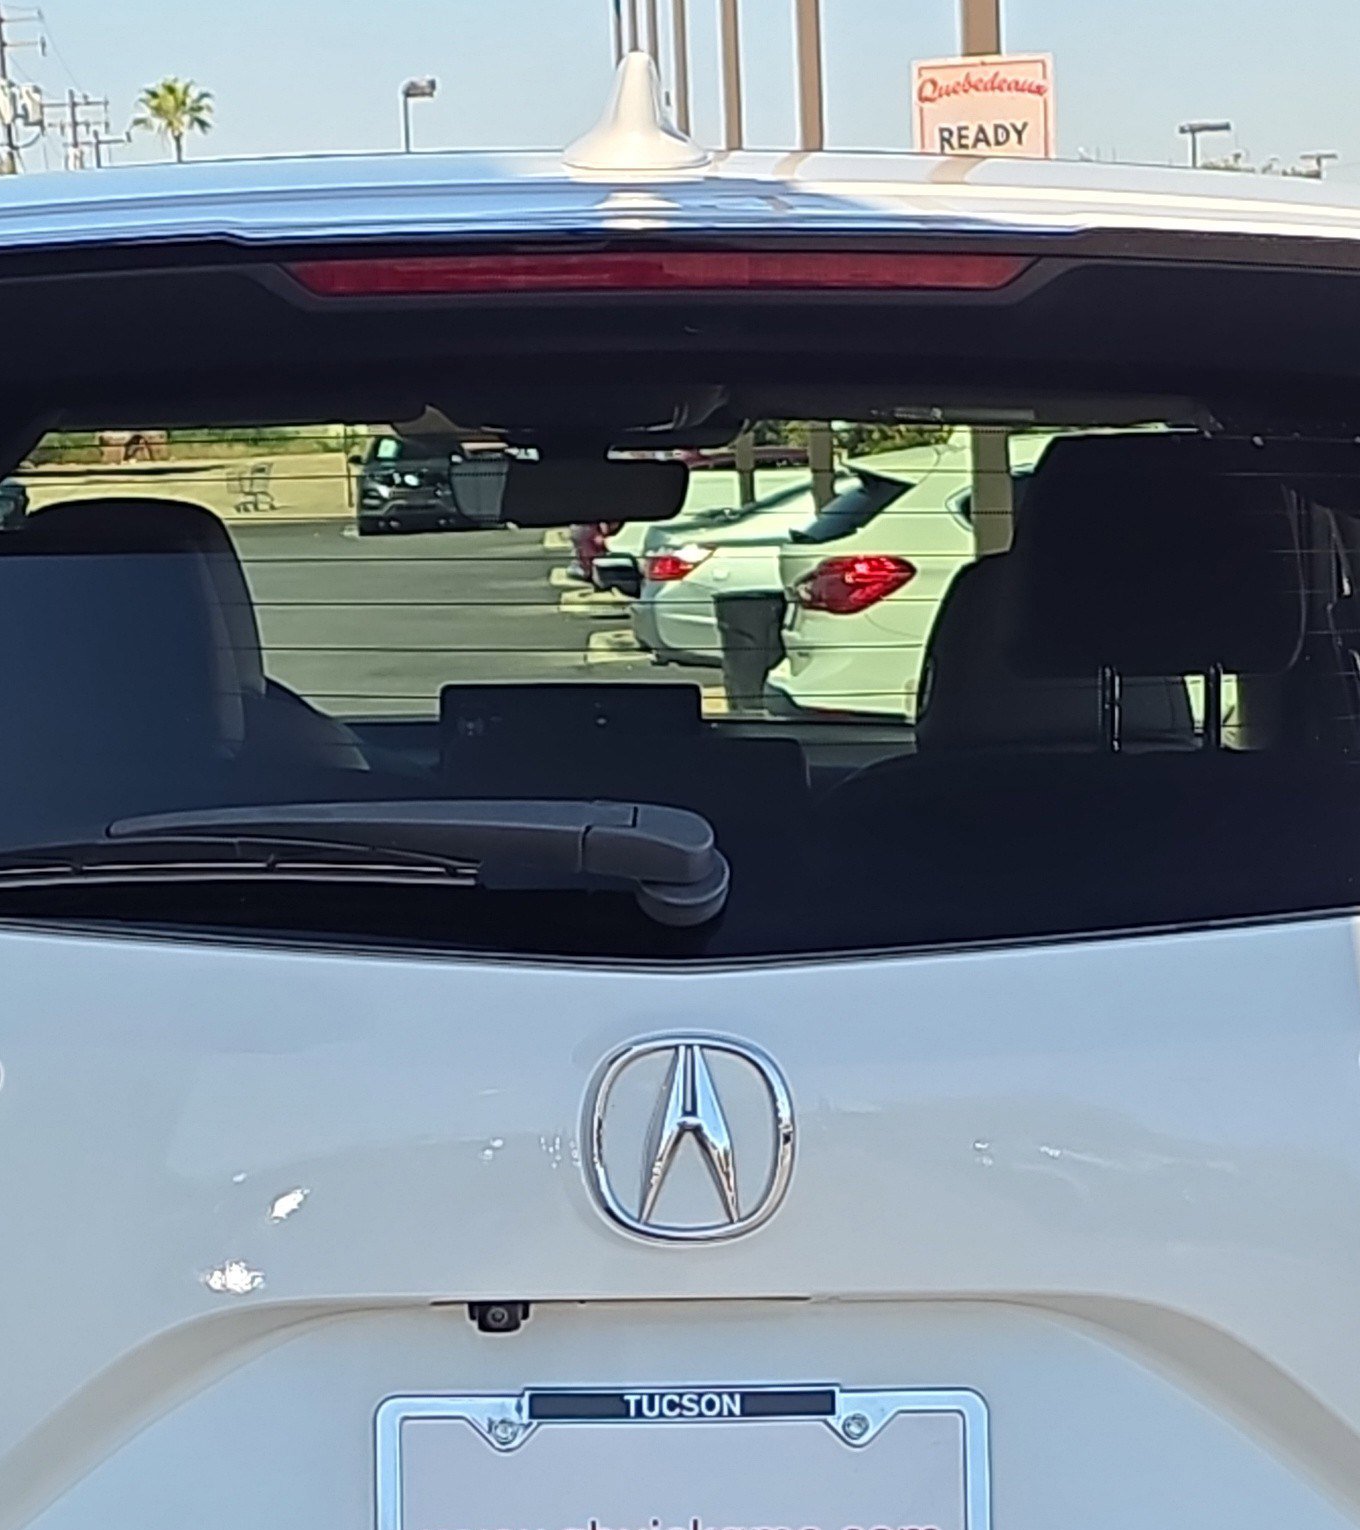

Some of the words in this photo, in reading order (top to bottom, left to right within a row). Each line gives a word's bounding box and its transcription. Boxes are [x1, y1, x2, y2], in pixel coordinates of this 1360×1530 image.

[917, 71, 1048, 103] Quebedeaux
[939, 121, 1029, 154] READY
[624, 1393, 742, 1419] TUCSON
